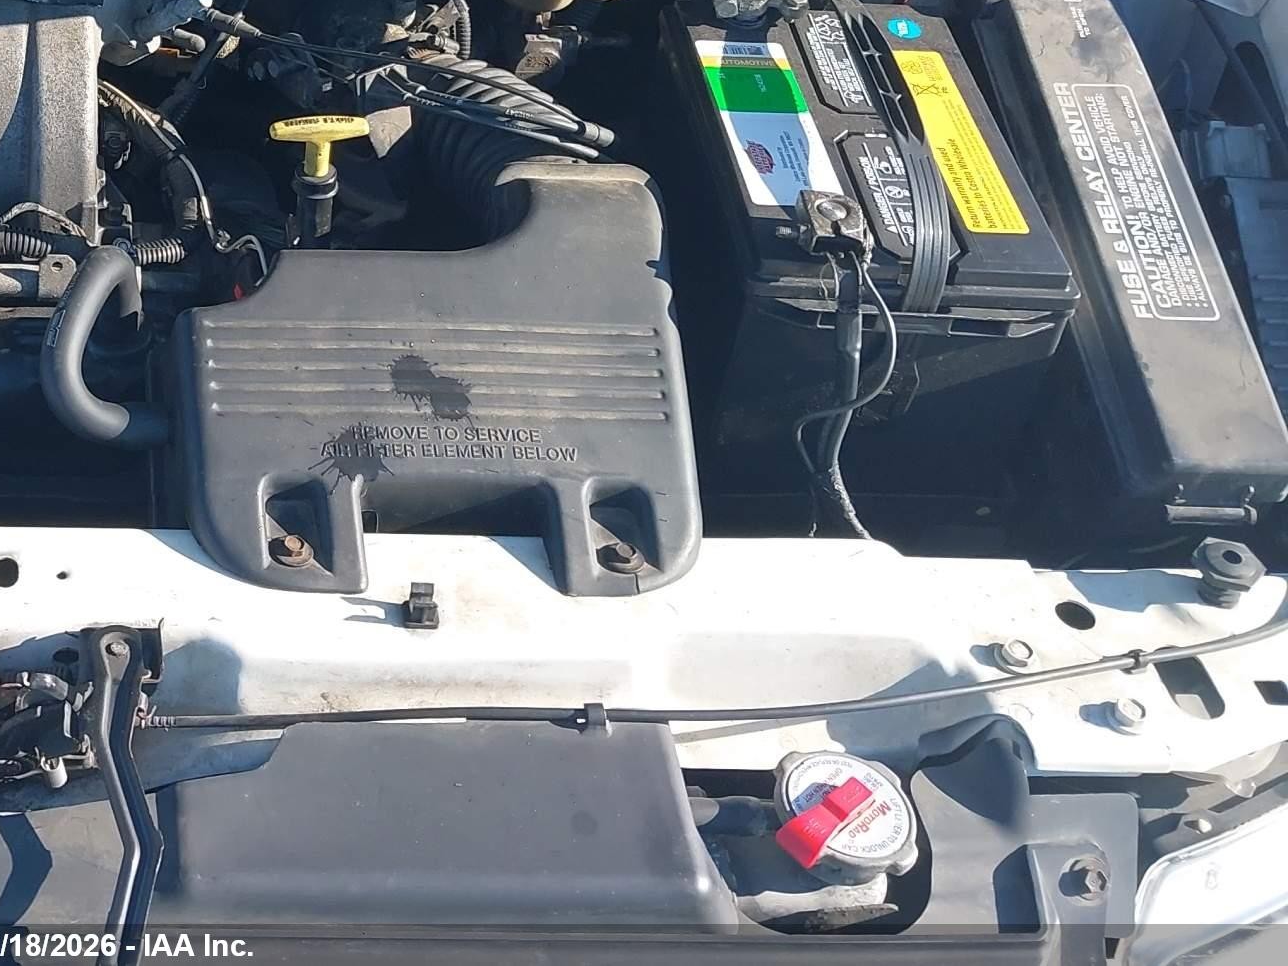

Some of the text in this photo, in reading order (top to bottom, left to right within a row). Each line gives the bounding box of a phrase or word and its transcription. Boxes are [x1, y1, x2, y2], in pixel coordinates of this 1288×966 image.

[1119, 95, 1136, 118] COVER
[936, 147, 951, 161] used
[944, 138, 969, 169] Wholesale
[1136, 155, 1149, 174] ONLY
[944, 163, 958, 175] and
[1052, 82, 1153, 318] FUSE & RELAY CENTER
[1083, 96, 1172, 307] CAUTION! TO HELP AVOID VEHICLE
[1093, 93, 1183, 306] DAMAGE AND/OR ENGINE NOT STARTING:
[1144, 177, 1161, 204] RELAYS
[1152, 179, 1174, 216] PROPERLY
[963, 205, 982, 227] Return
[974, 199, 998, 228] batteries
[1122, 141, 1190, 300] DISCONNECT BATTERY BEFORE SERVICING
[1158, 216, 1175, 240] FUSES
[1168, 243, 1191, 281] SPECIFIED
[1186, 268, 1207, 301] ALWAYS
[352, 425, 543, 444] REMOVE TO SERVICE
[422, 443, 505, 459] ELEMENT
[512, 445, 578, 462] BELOW
